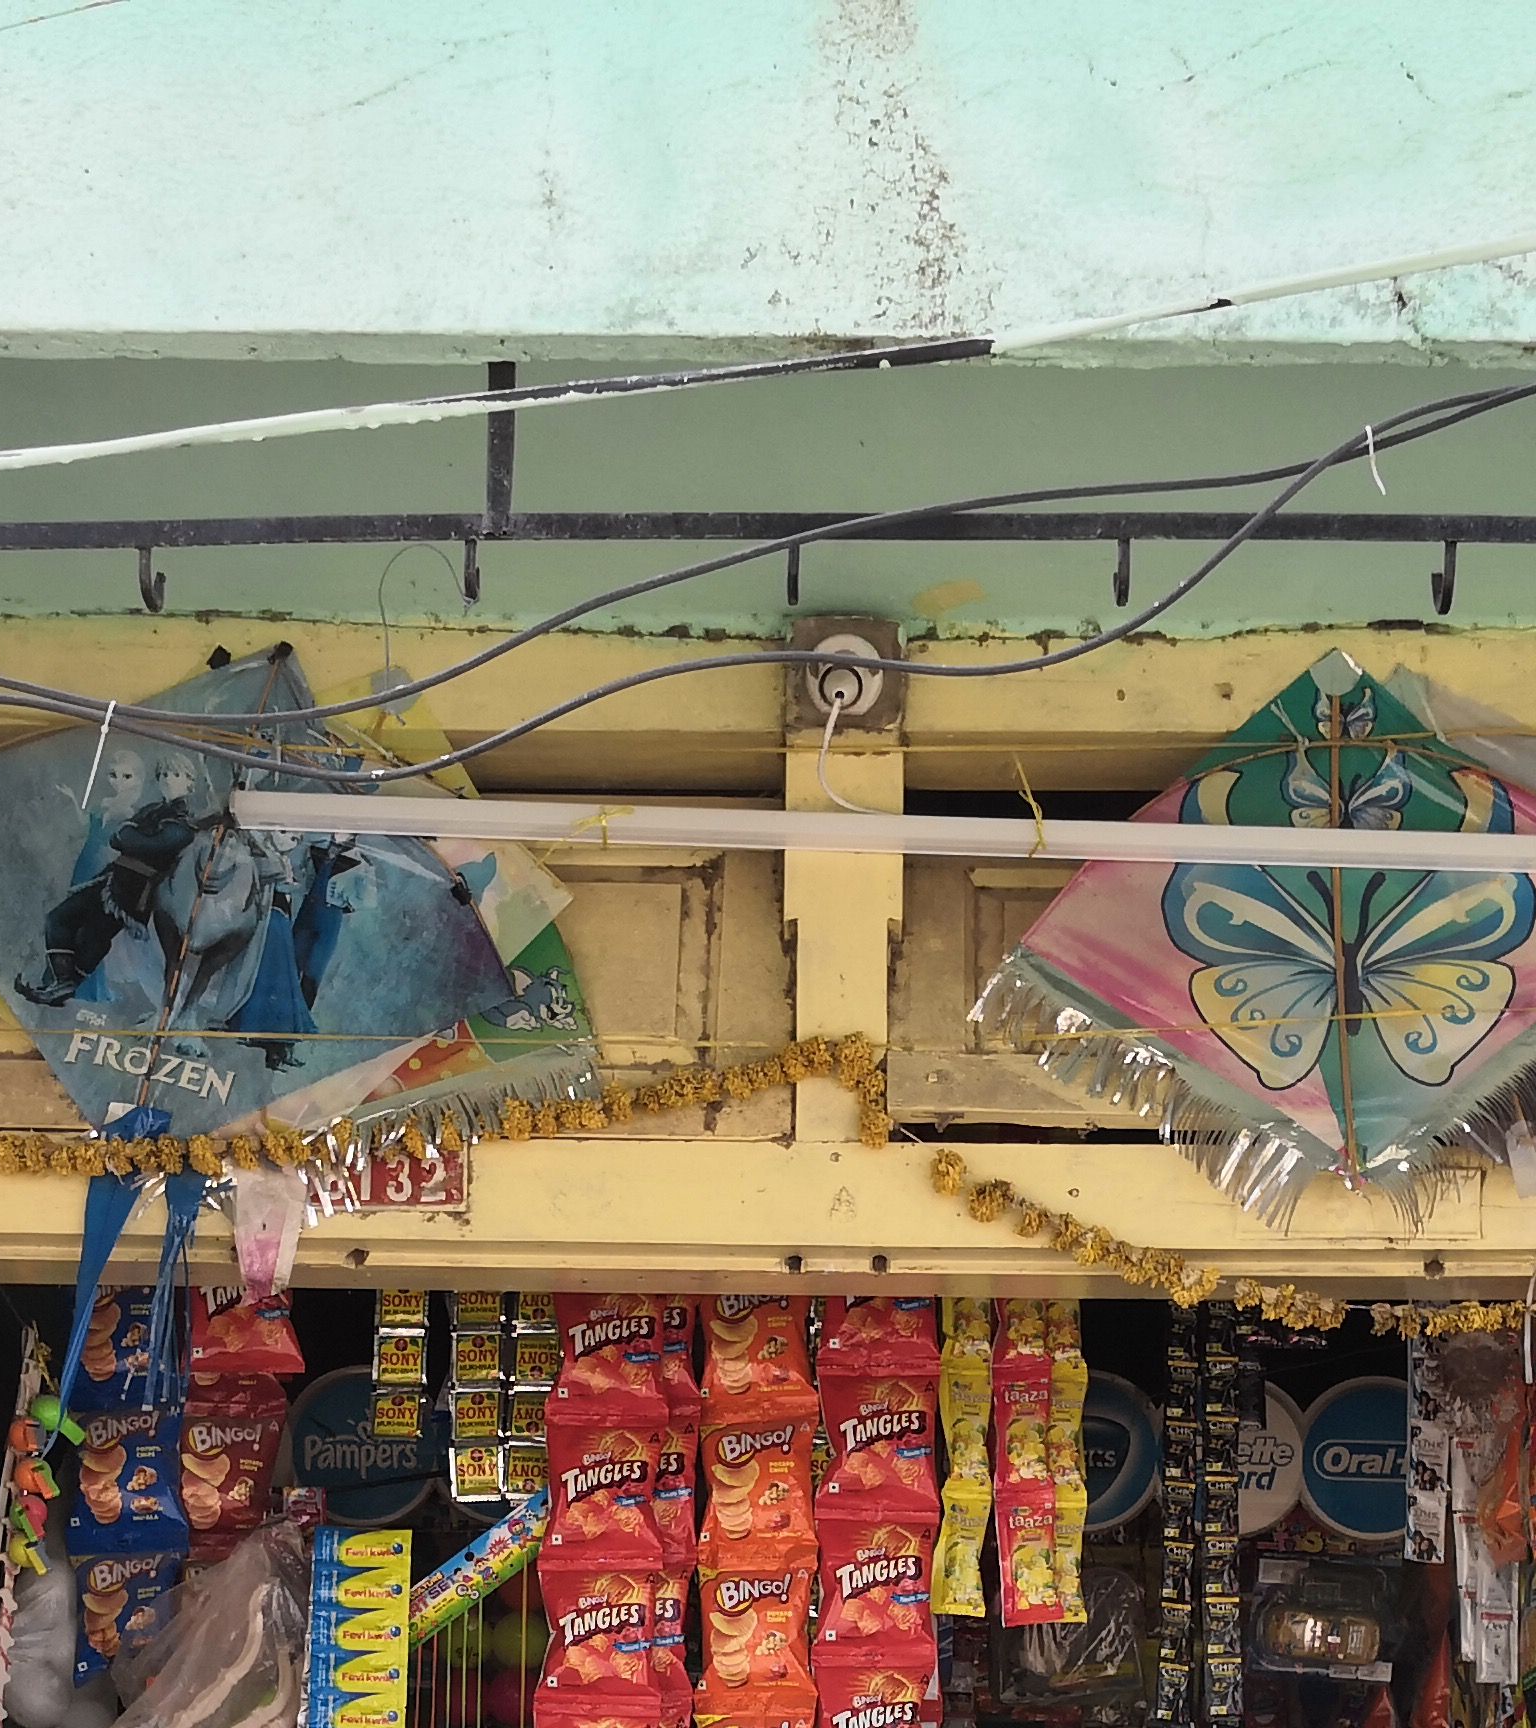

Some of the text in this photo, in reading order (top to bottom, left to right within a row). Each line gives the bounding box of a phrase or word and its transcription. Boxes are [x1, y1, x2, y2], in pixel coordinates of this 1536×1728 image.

[65, 1029, 235, 1105] FROZEN
[383, 1294, 423, 1308] SONY
[459, 1292, 497, 1305] SONY
[569, 1317, 650, 1356] TANGLES
[380, 1352, 420, 1366] SONY
[458, 1350, 497, 1362] SONY
[376, 1406, 417, 1419] SONY
[457, 1406, 497, 1419] SONY
[1005, 1388, 1048, 1403] taaza
[89, 1411, 160, 1446] BINGO!
[194, 1424, 262, 1451] BINGO!
[723, 1425, 794, 1461] BINGO!
[840, 1412, 920, 1451] TANGLES
[304, 1435, 418, 1479] Pampers
[458, 1463, 496, 1477] SONY
[562, 1461, 642, 1502] TANGLES
[1009, 1513, 1053, 1529] taaza
[95, 1554, 163, 1590] BINGO!
[836, 1557, 916, 1599] TANGLES
[719, 1573, 791, 1609] BINGO!
[560, 1603, 639, 1646] TANGLES
